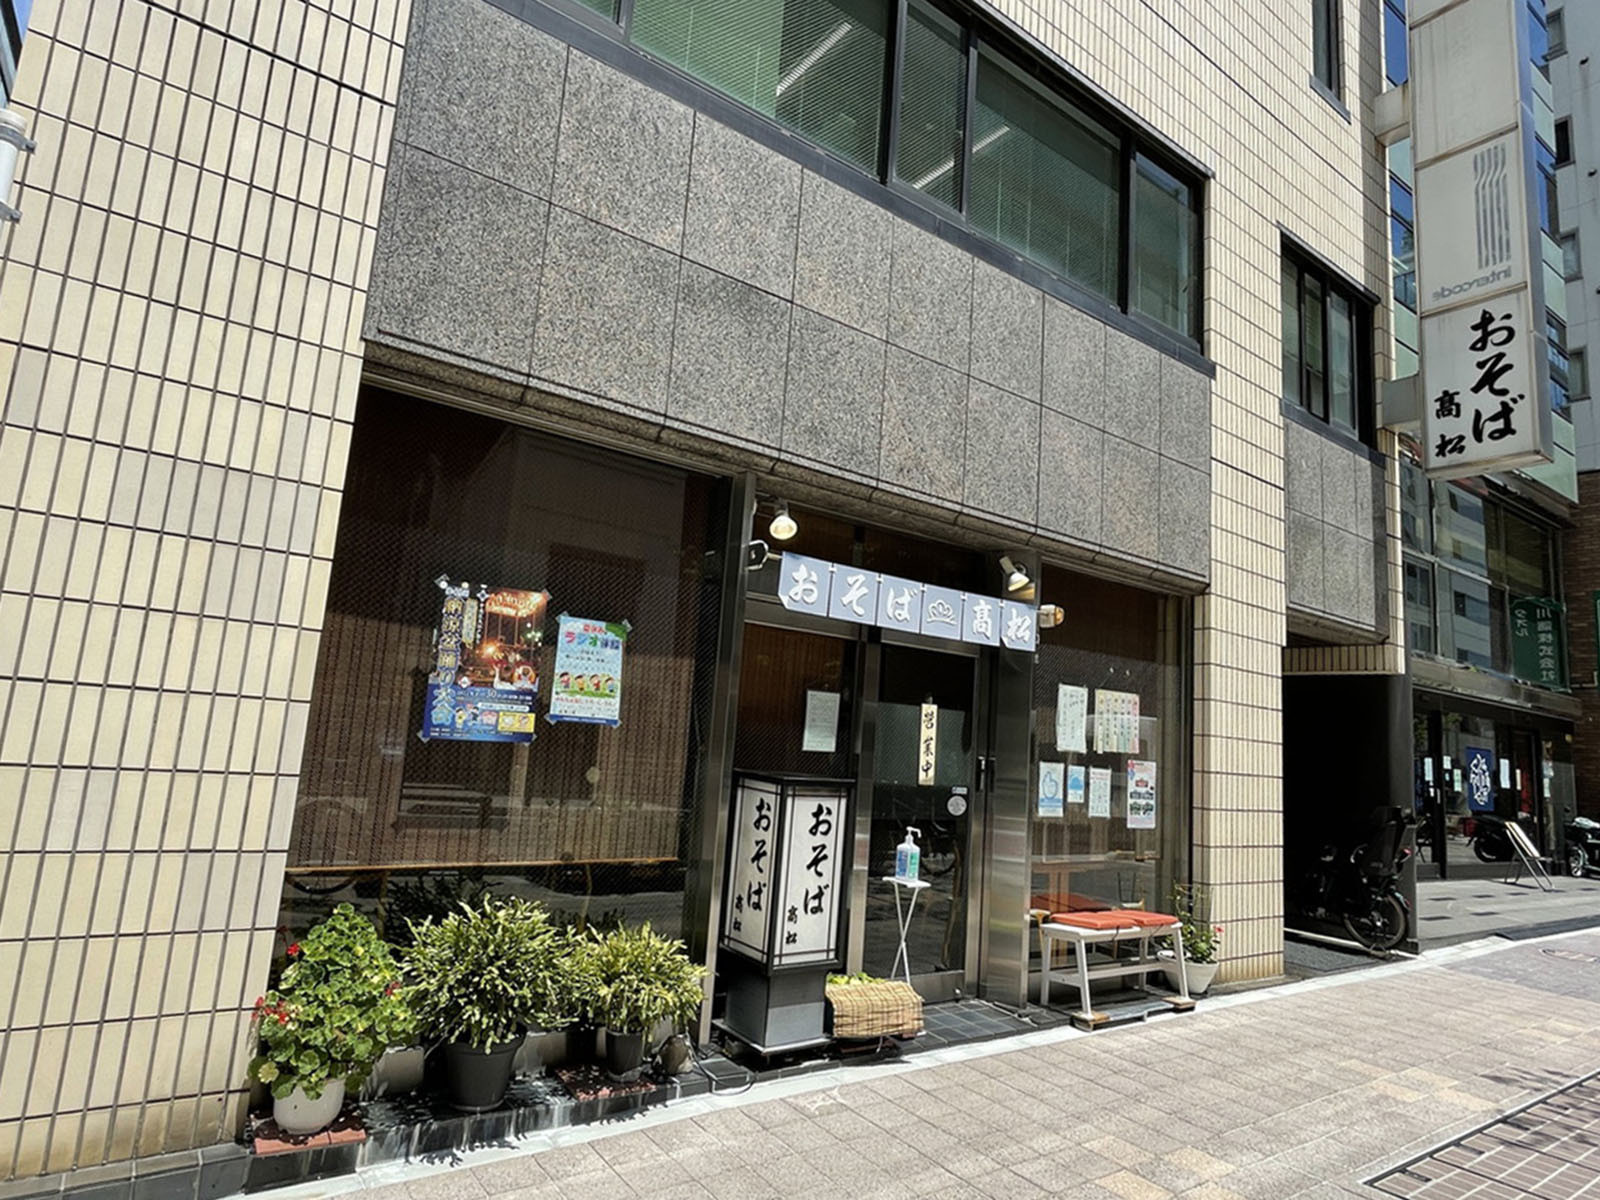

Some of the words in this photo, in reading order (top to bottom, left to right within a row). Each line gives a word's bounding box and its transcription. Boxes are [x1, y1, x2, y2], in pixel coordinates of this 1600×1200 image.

[1468, 308, 1526, 444] おそば
[788, 564, 918, 623] おそば
[747, 797, 772, 913] おそば
[803, 803, 833, 915] おそば
